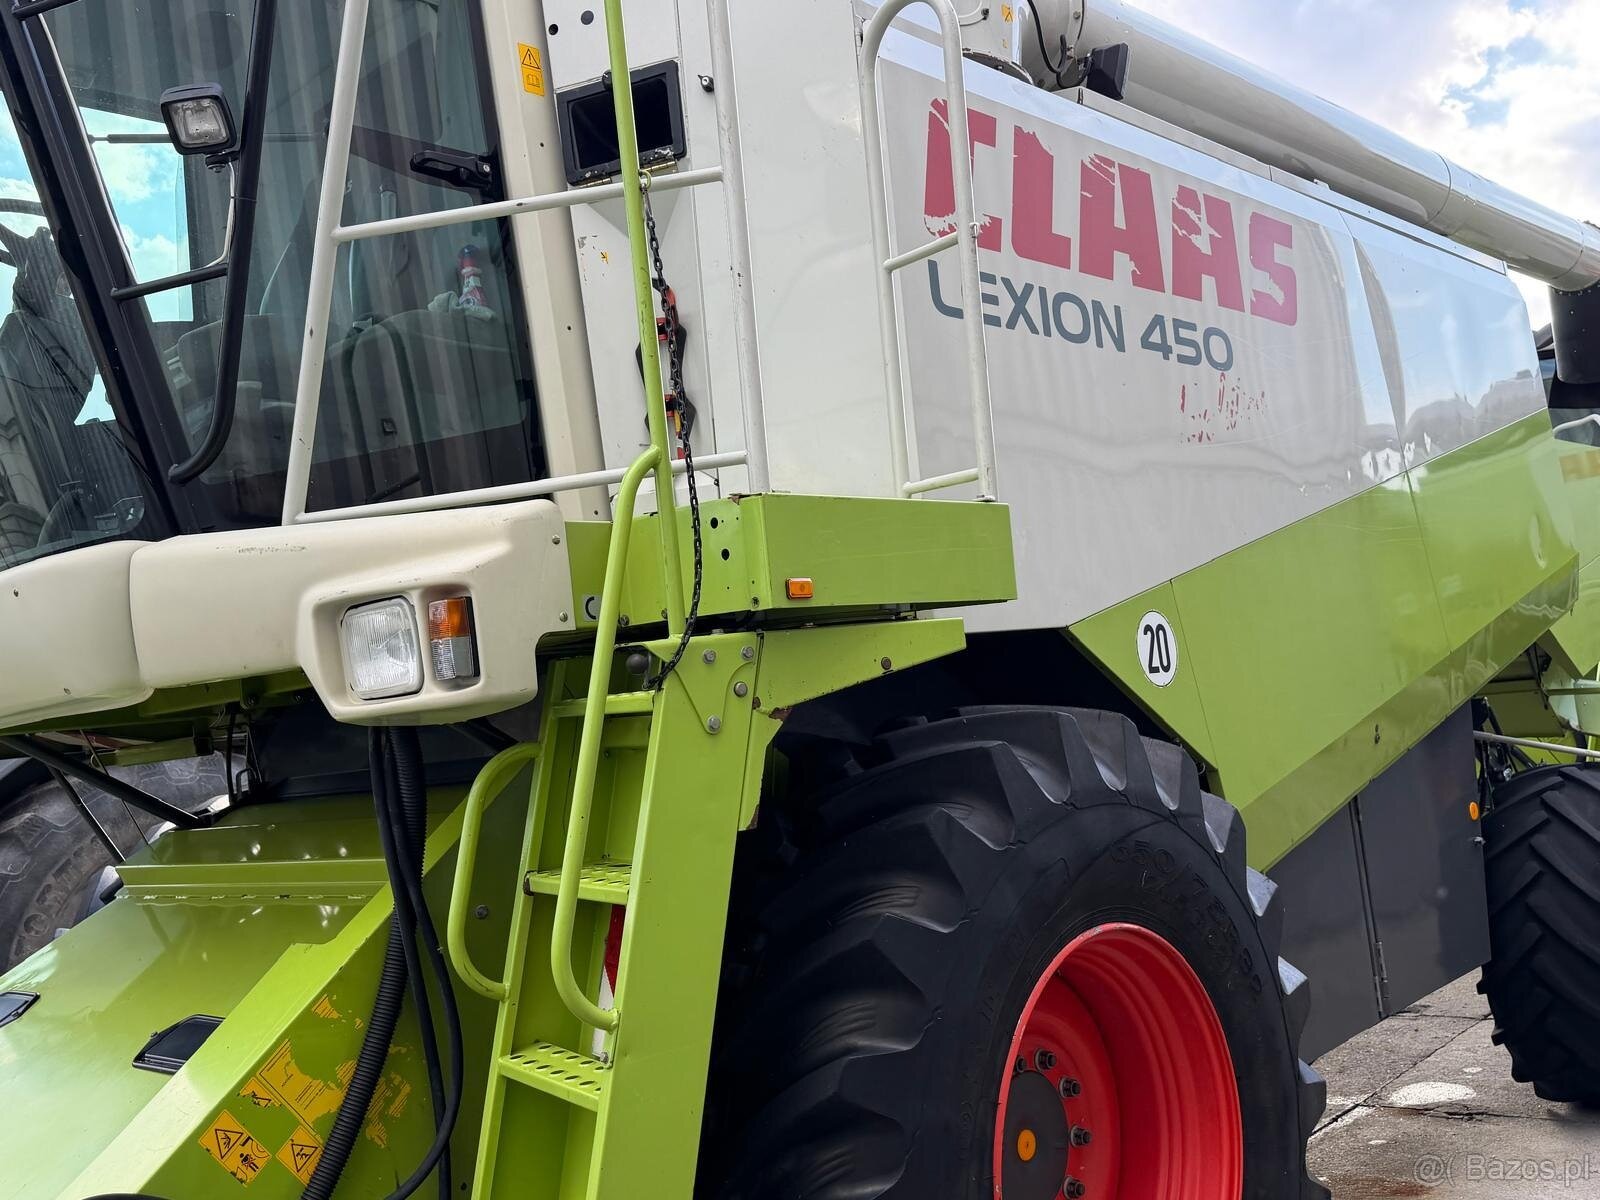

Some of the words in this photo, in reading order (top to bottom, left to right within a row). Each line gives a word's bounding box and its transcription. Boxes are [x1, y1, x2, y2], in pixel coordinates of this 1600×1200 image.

[924, 97, 1298, 327] CLAAS
[927, 259, 1126, 353] LEXION
[1139, 313, 1234, 372] 450
[1143, 623, 1171, 674] 20
